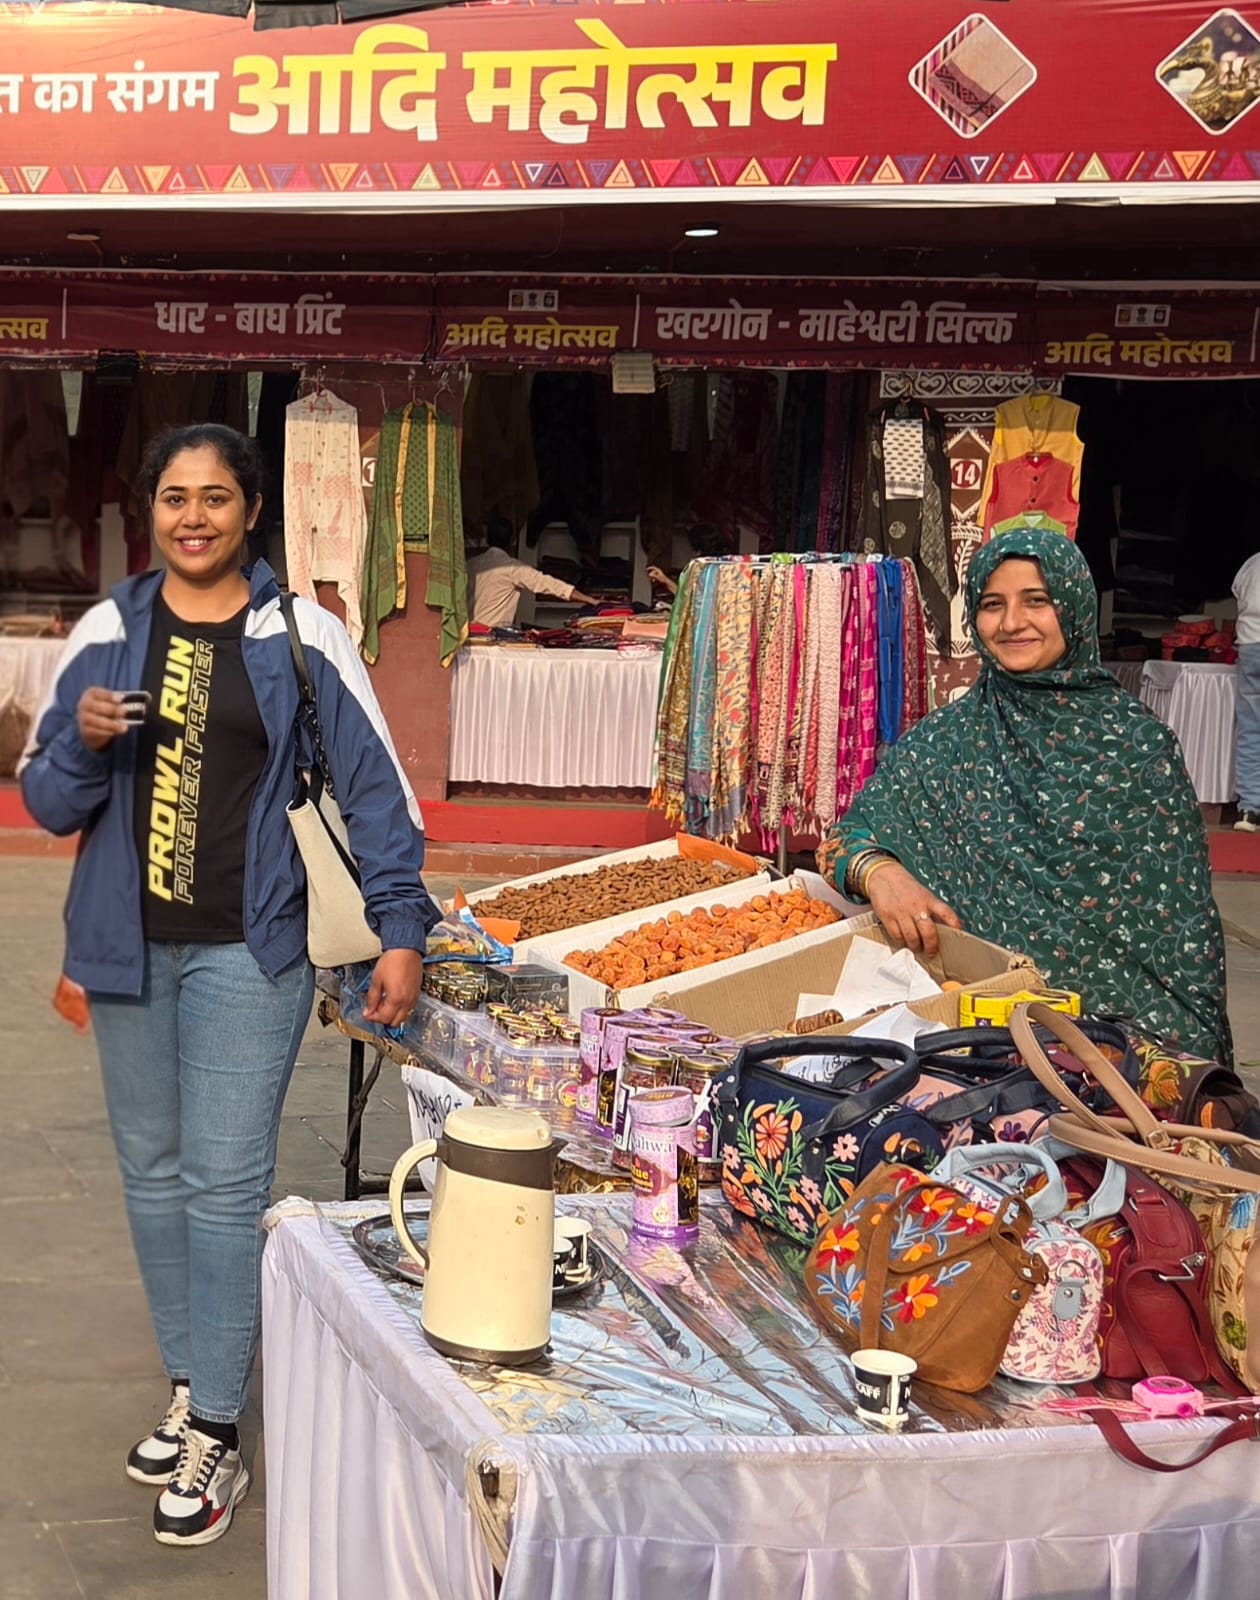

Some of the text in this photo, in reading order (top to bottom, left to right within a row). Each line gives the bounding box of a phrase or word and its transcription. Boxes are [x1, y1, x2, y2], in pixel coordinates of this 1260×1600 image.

[32, 73, 97, 112] का
[105, 60, 220, 112] संगम
[229, 24, 446, 141] आदि
[462, 19, 838, 144] महोत्सव
[154, 302, 208, 334] धार
[233, 302, 290, 335] बाघ
[294, 292, 346, 335] प्रिंट
[446, 316, 620, 350] आदि महोत्सव
[655, 298, 773, 341] खरगोन
[798, 299, 921, 342] माहेश्वरी
[925, 300, 1018, 344] सिल्क
[1044, 332, 1233, 368] आदि महोत्सव
[954, 463, 977, 485] 14
[148, 635, 195, 901] PROWL RUN
[174, 638, 214, 905] FOREVER FASTER
